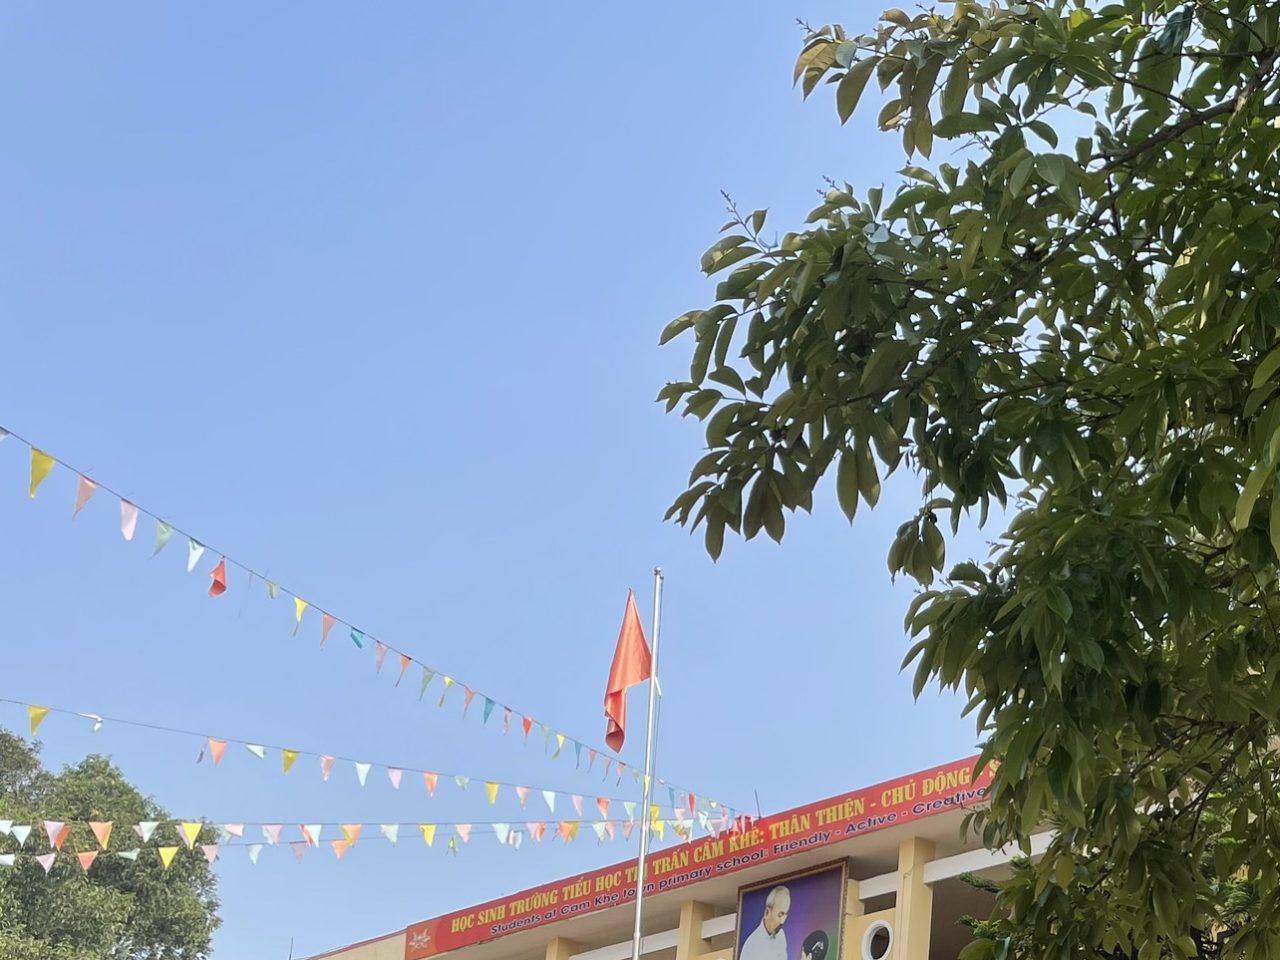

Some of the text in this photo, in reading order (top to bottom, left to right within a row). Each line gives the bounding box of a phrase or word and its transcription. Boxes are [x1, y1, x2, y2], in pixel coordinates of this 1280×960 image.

[451, 913, 475, 933] HỌC
[478, 905, 506, 925] SINH
[509, 889, 558, 917] TRƯỜNG
[562, 877, 591, 901] TIỂU
[595, 871, 622, 892] HỌC
[653, 848, 689, 875] TRẤN
[769, 814, 811, 840] THÂN
[815, 798, 865, 826] THIỆN
[881, 779, 917, 808] CHỦ
[922, 767, 971, 797] ĐỘNG
[491, 915, 541, 935] Students
[544, 908, 558, 920] at
[561, 900, 590, 915] Cam
[595, 892, 619, 906] Khe
[660, 866, 712, 890] primary
[773, 830, 830, 855] Friendly
[845, 812, 897, 834] Active
[912, 787, 987, 815] Creative
